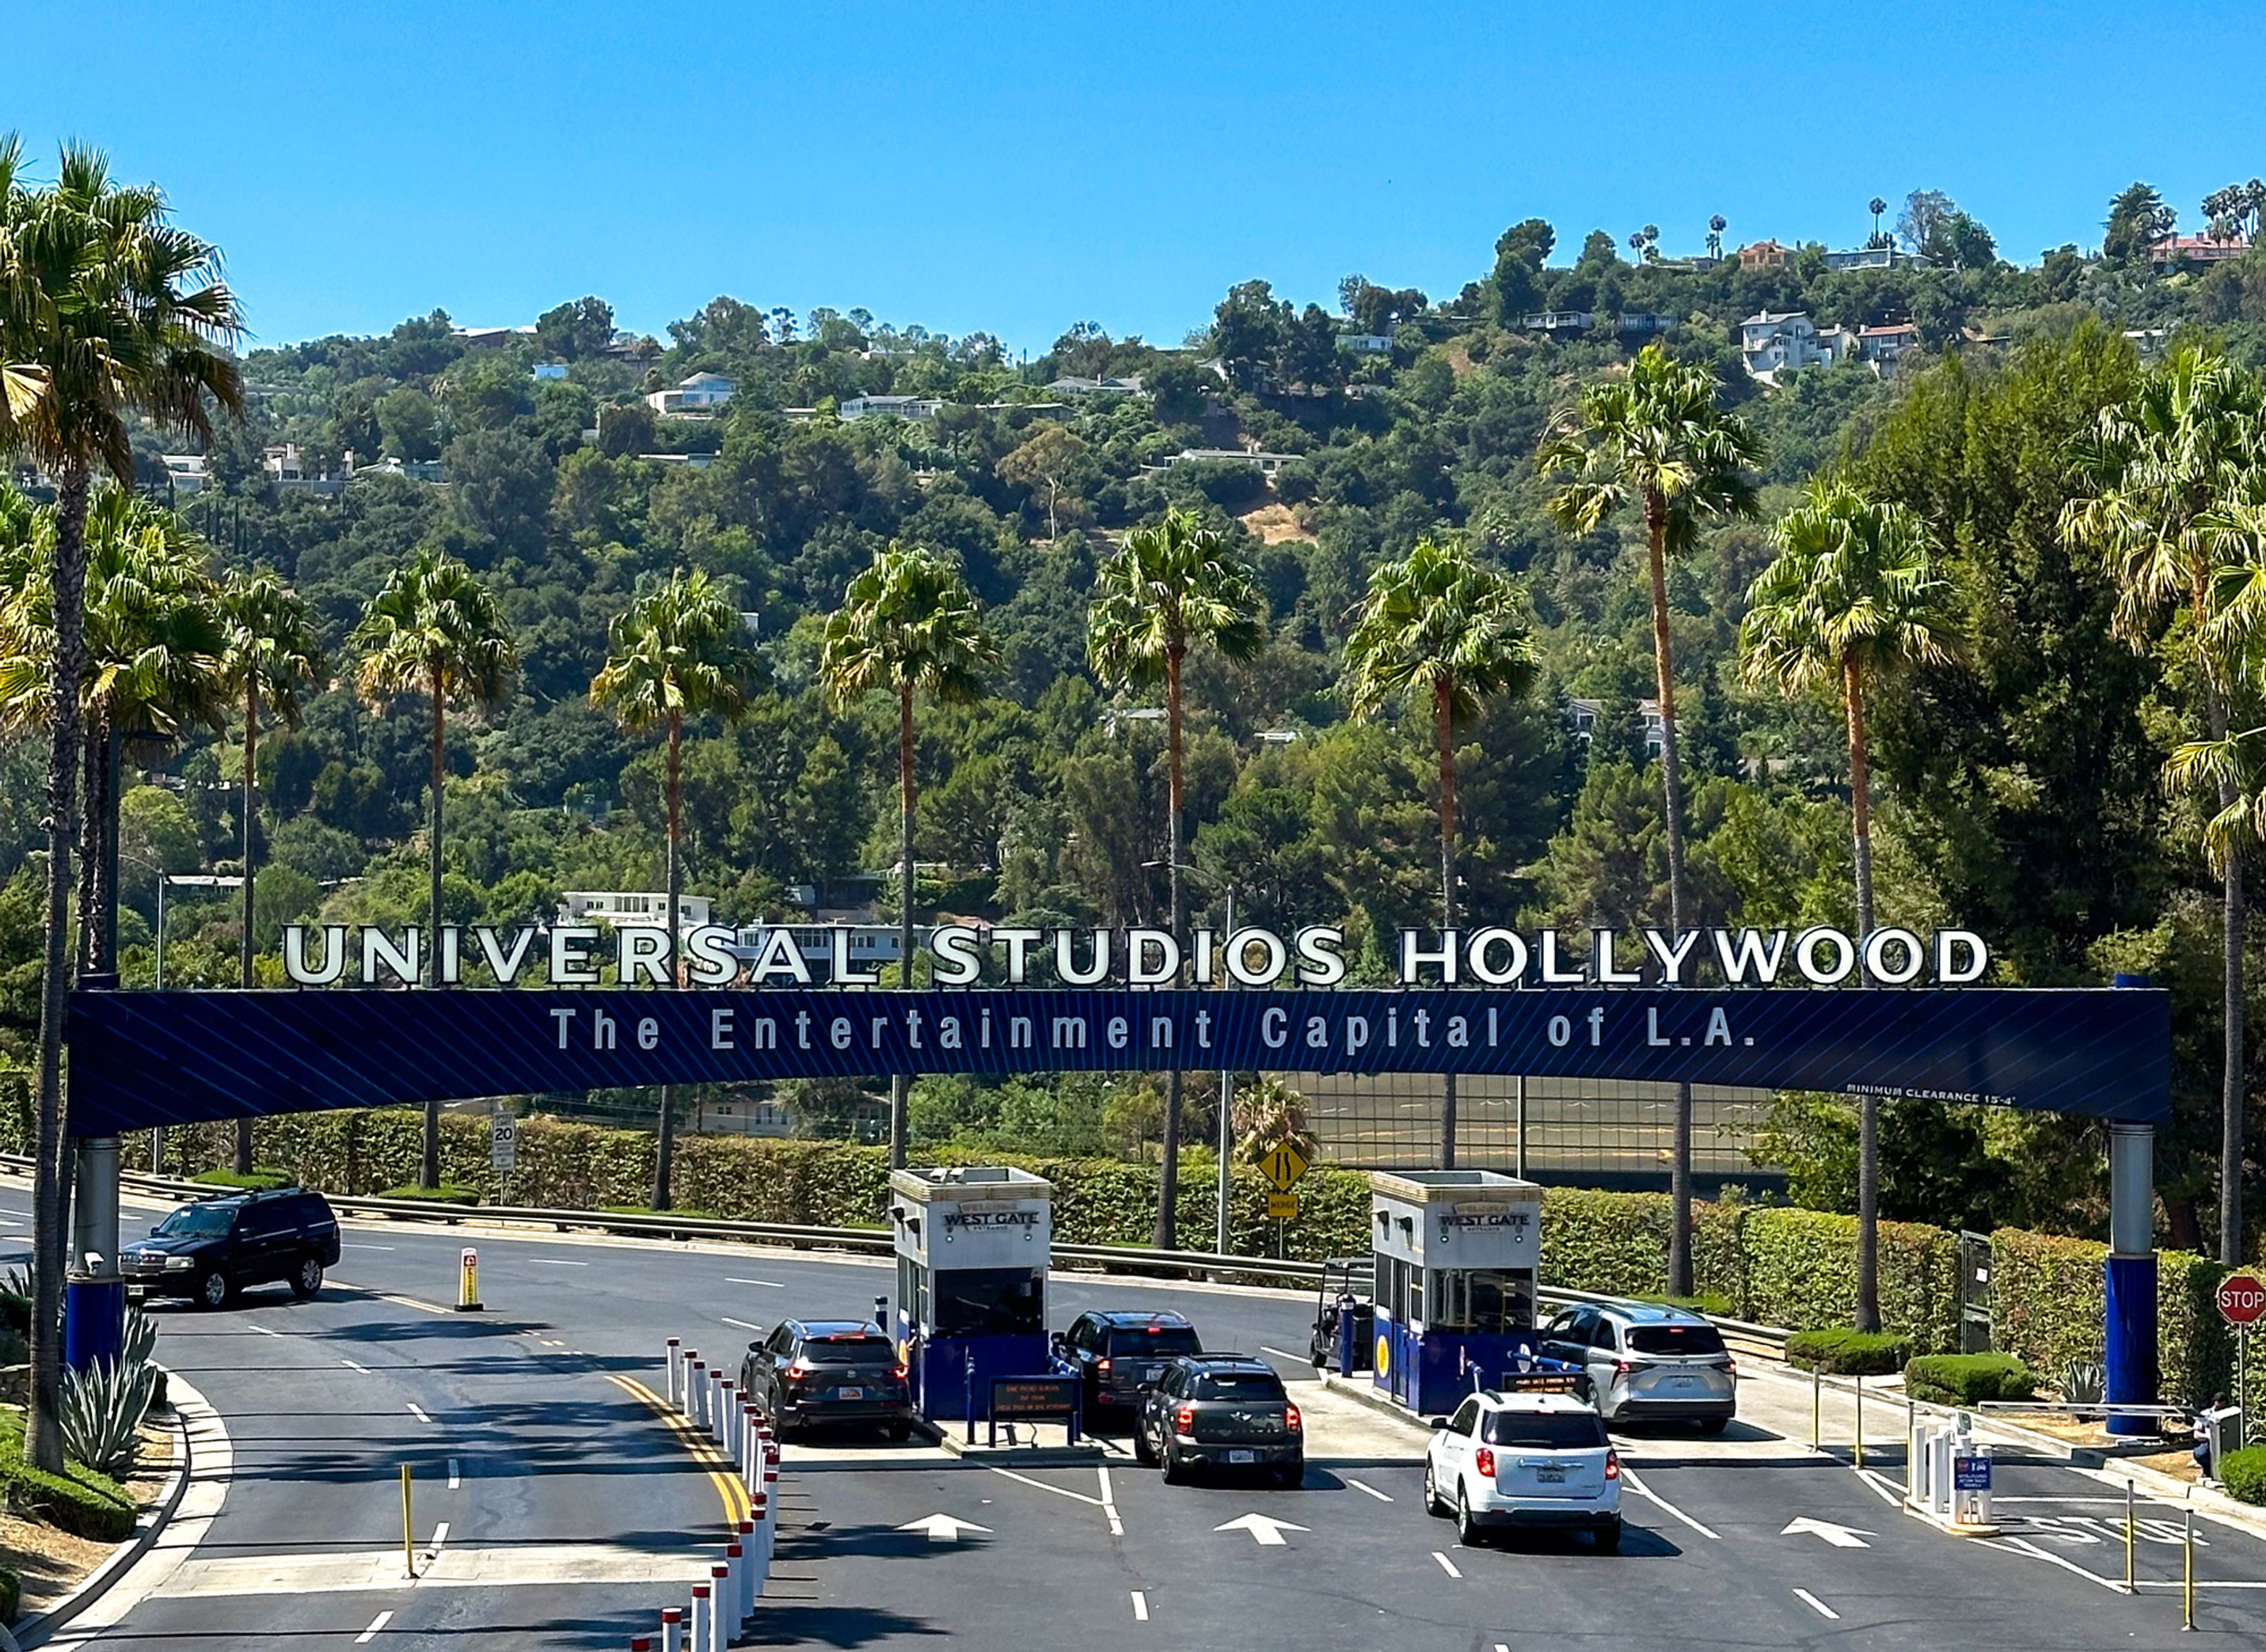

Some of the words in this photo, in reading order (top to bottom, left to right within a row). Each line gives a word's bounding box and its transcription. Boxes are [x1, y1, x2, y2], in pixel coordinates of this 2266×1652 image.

[283, 925, 880, 986] UNIVERSAL
[930, 925, 1347, 987] STUDIOS
[1399, 925, 1990, 986] HOLLYWOOD
[549, 1008, 660, 1050] The
[711, 1008, 1211, 1050] Entertainment
[1261, 1006, 1498, 1057] Capital
[1548, 1006, 1605, 1047] of
[1647, 1006, 1755, 1046] L.A.
[1846, 1084, 1902, 1096] MINIMUM
[1906, 1088, 1979, 1102] CLEARANCE
[495, 1127, 512, 1141] 20
[943, 1213, 990, 1225] WEST
[995, 1212, 1040, 1225] GATE
[1439, 1213, 1484, 1226] WEST
[1488, 1213, 1530, 1226] GATE
[2220, 1290, 2265, 1308] STOP
